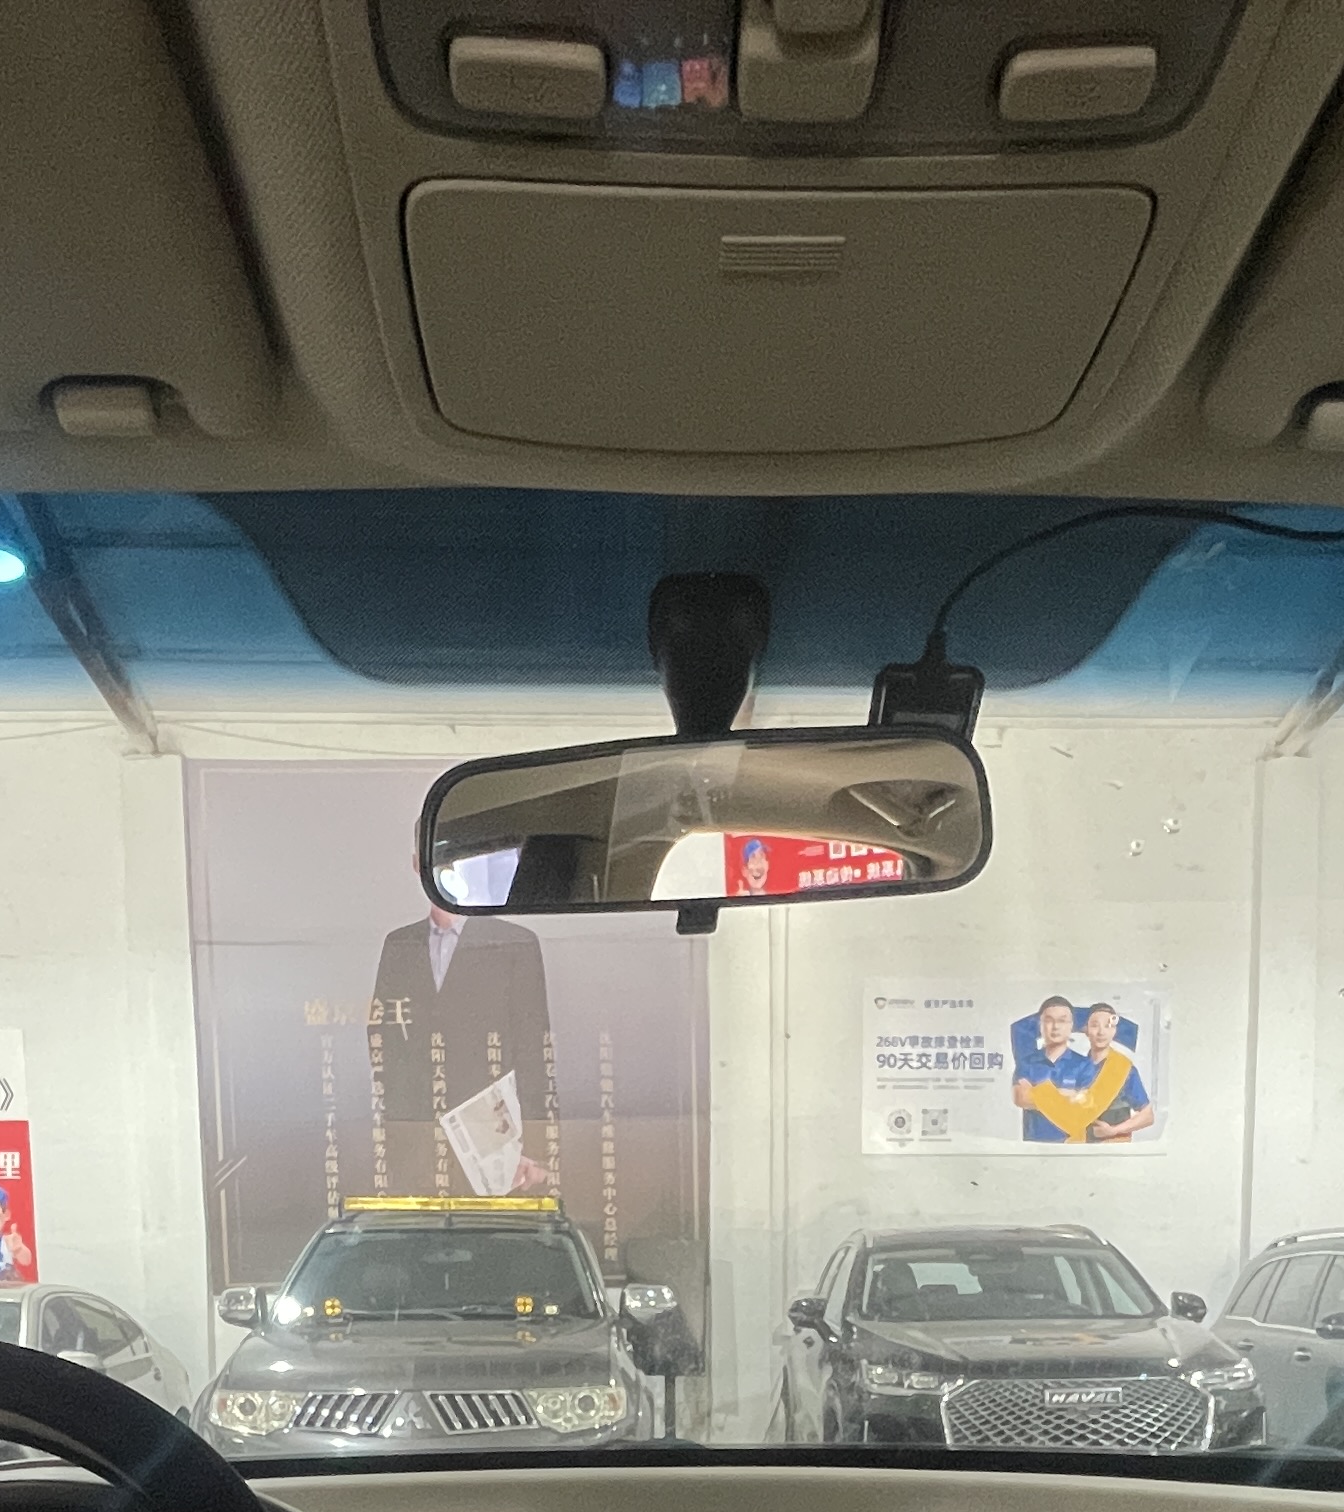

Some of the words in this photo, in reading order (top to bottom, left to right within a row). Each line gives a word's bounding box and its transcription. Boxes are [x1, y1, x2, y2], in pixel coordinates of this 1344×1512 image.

[876, 1052, 1004, 1070] 90天交易价回购
[1051, 1392, 1119, 1404] HAVAL
